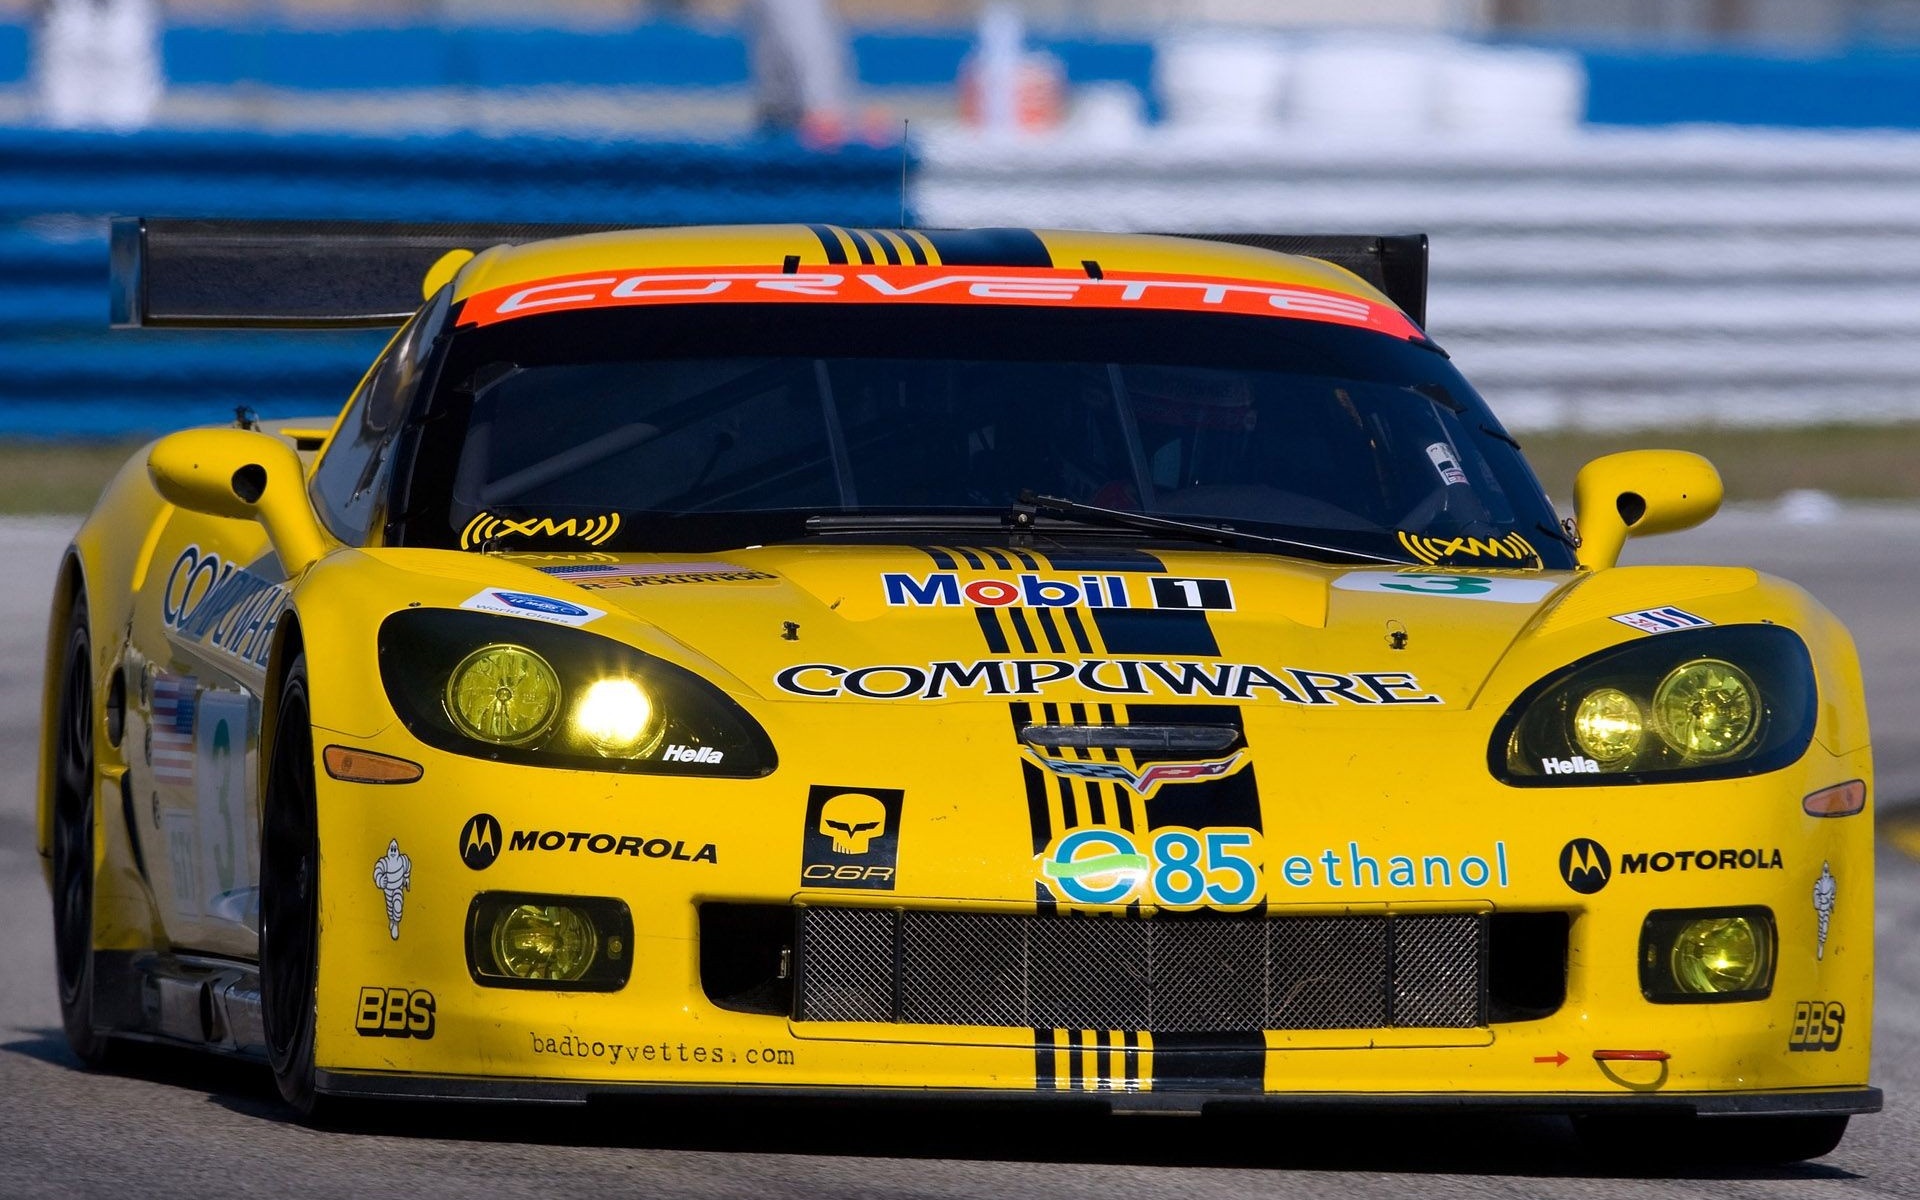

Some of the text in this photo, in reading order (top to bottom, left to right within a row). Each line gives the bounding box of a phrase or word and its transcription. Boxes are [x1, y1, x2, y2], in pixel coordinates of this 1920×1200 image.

[495, 272, 1371, 322] CORVETTE
[882, 573, 1131, 608] Mobil
[1378, 574, 1493, 595] 3
[475, 604, 569, 624] World Class
[774, 658, 1444, 706] COMPUWARE
[662, 744, 724, 764] Hella
[1541, 756, 1601, 775] Hella
[508, 830, 718, 864] MOTOROLA
[1620, 848, 1784, 874] MOTOROLA
[803, 864, 895, 881] C6R
[1283, 841, 1509, 888] ethanol
[355, 986, 437, 1041] BBS
[1788, 1001, 1846, 1052] BBS
[529, 1032, 796, 1065] badboyvettes.com
